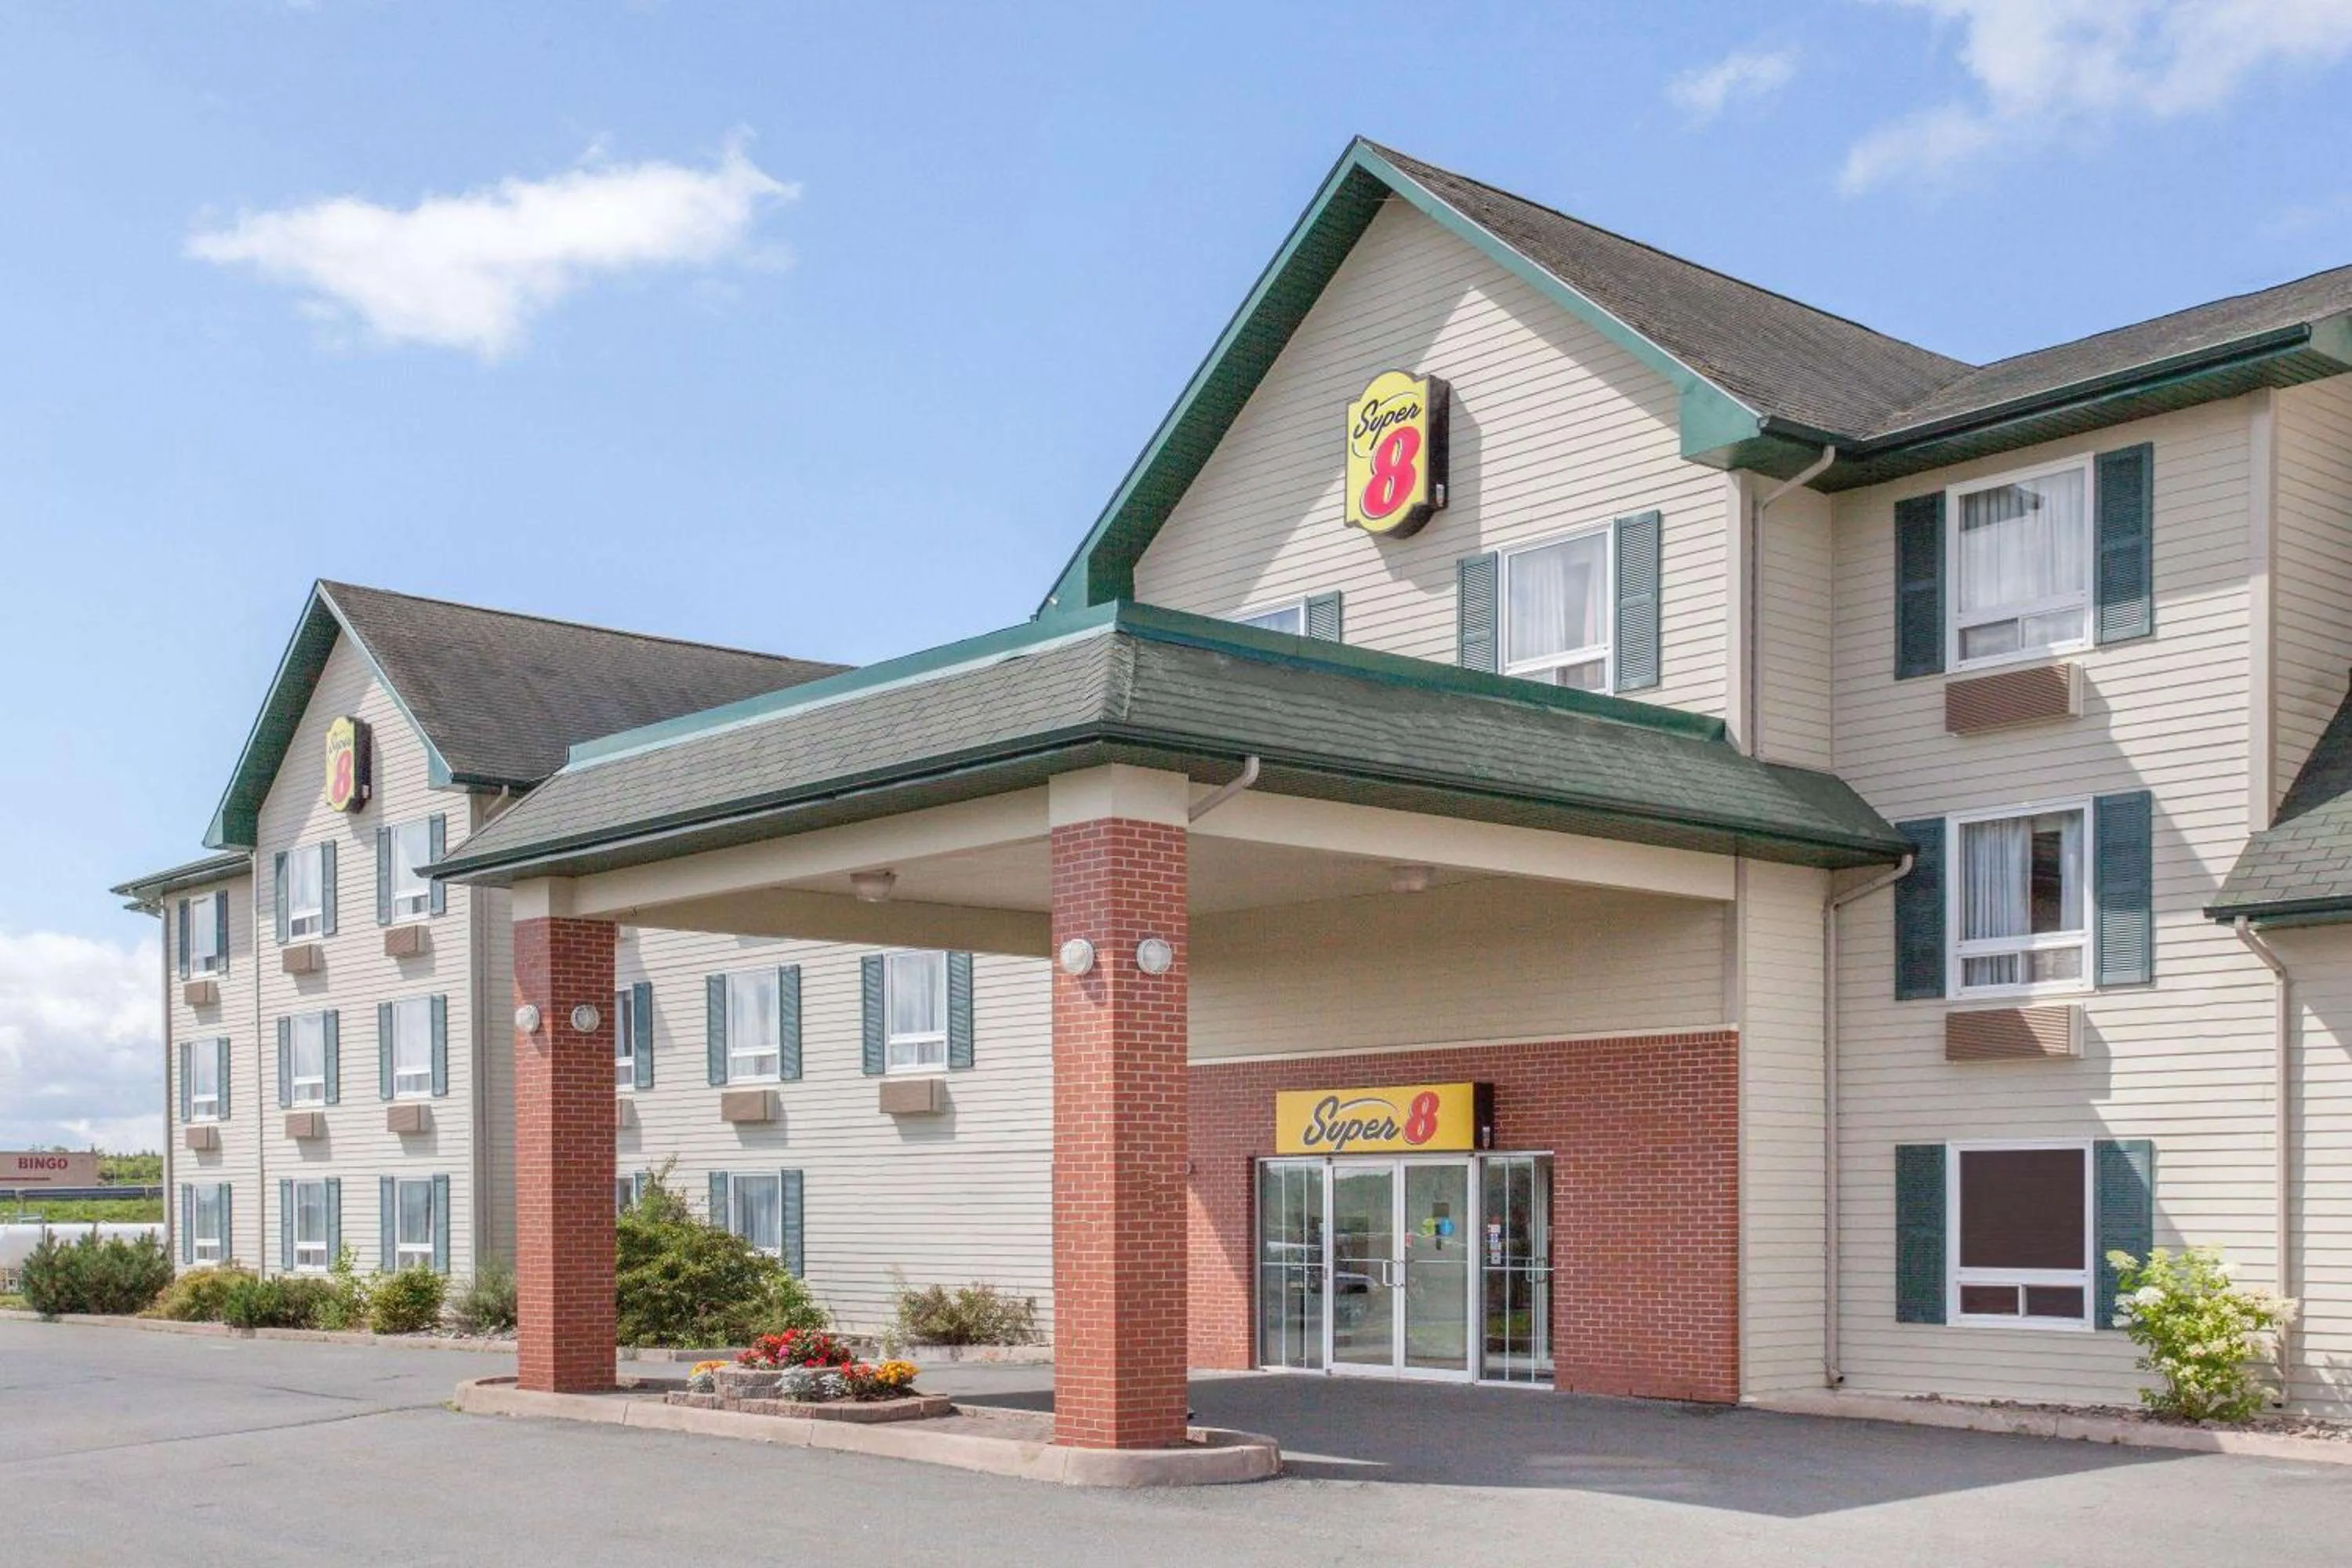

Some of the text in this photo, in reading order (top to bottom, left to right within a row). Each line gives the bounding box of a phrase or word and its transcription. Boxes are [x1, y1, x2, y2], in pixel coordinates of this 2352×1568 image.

[1352, 398, 1421, 451] Super
[1359, 426, 1421, 519] 8
[332, 749, 352, 804] 8
[1302, 1091, 1440, 1149] Super 8
[18, 1156, 68, 1170] BINGO
